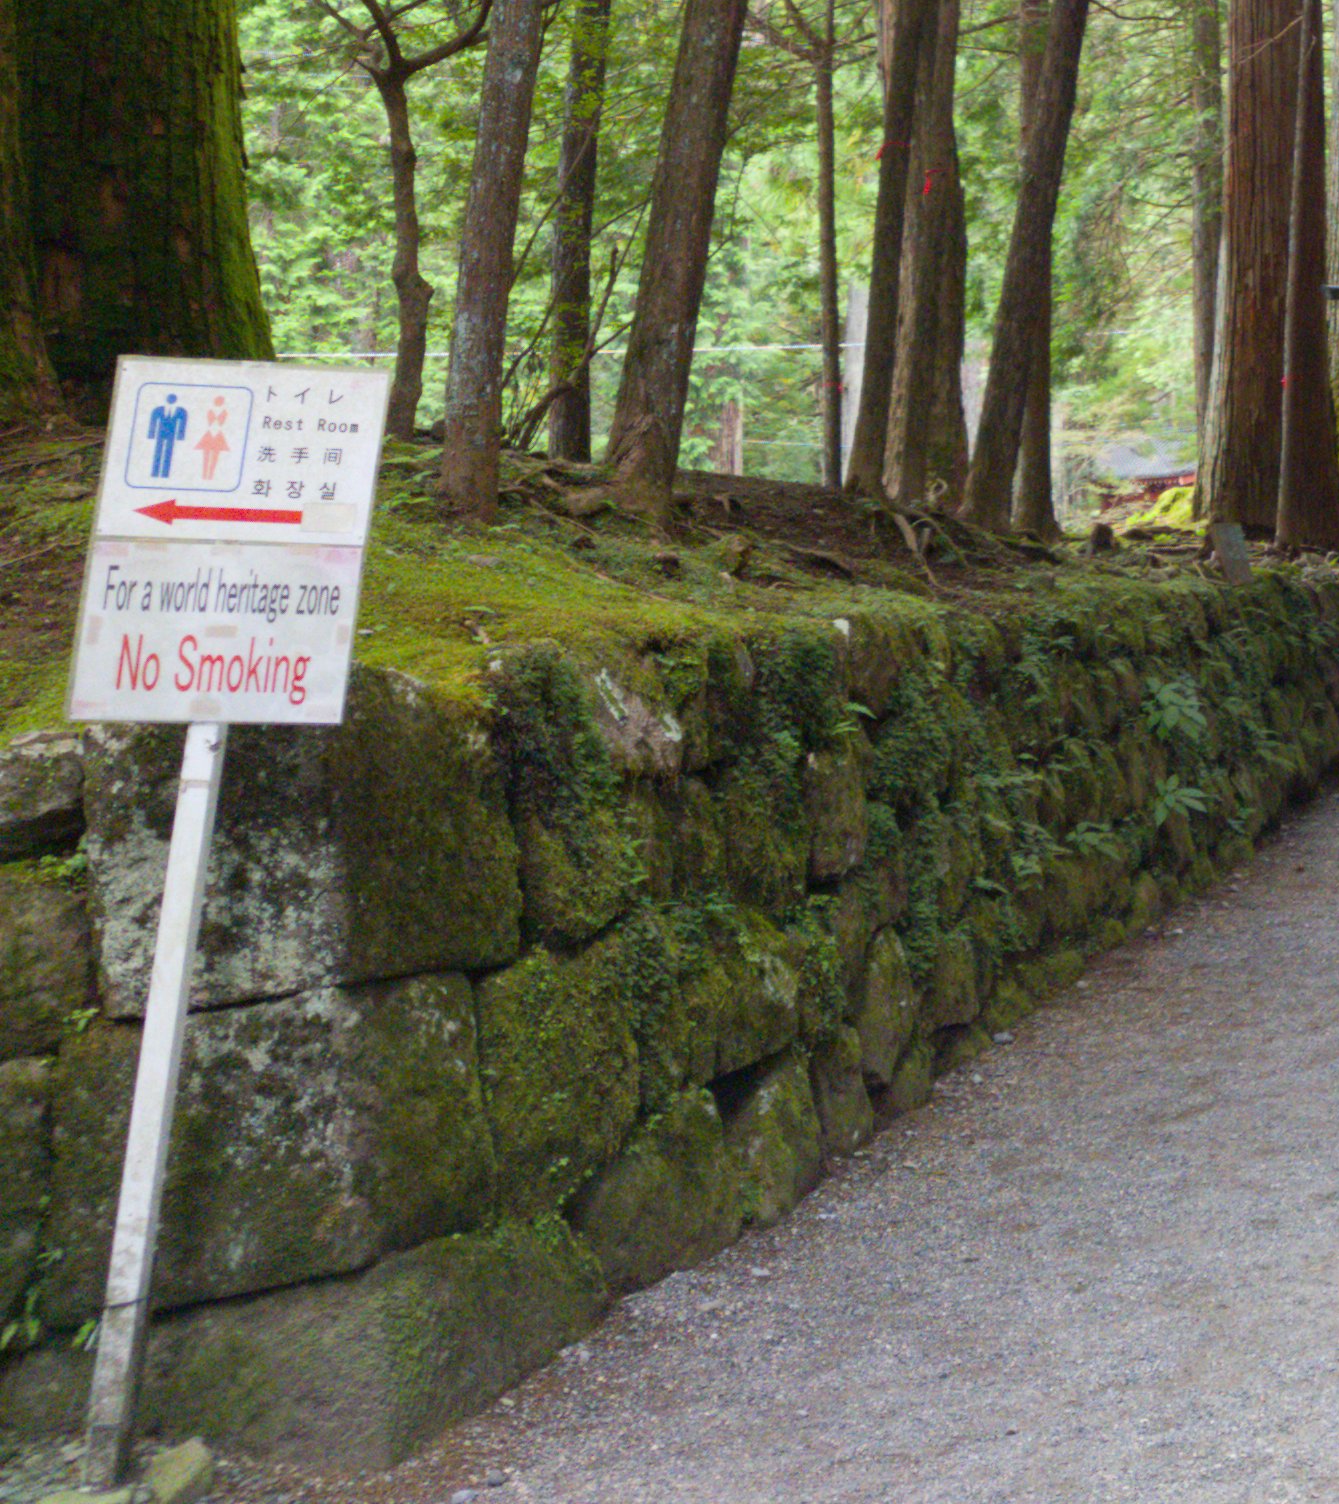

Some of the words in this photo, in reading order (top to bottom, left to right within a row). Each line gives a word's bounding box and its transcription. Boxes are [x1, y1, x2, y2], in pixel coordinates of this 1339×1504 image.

[266, 385, 344, 405] トイレ
[262, 415, 304, 431] Rest
[317, 417, 359, 434] Room
[257, 445, 343, 465] 洗手间
[251, 479, 337, 501] 화장실
[103, 565, 136, 612] For
[140, 581, 152, 612] a
[159, 566, 213, 613] world
[214, 568, 290, 623] heritage
[295, 582, 341, 616] zone
[116, 633, 160, 692] No
[174, 634, 311, 706] Smoking
